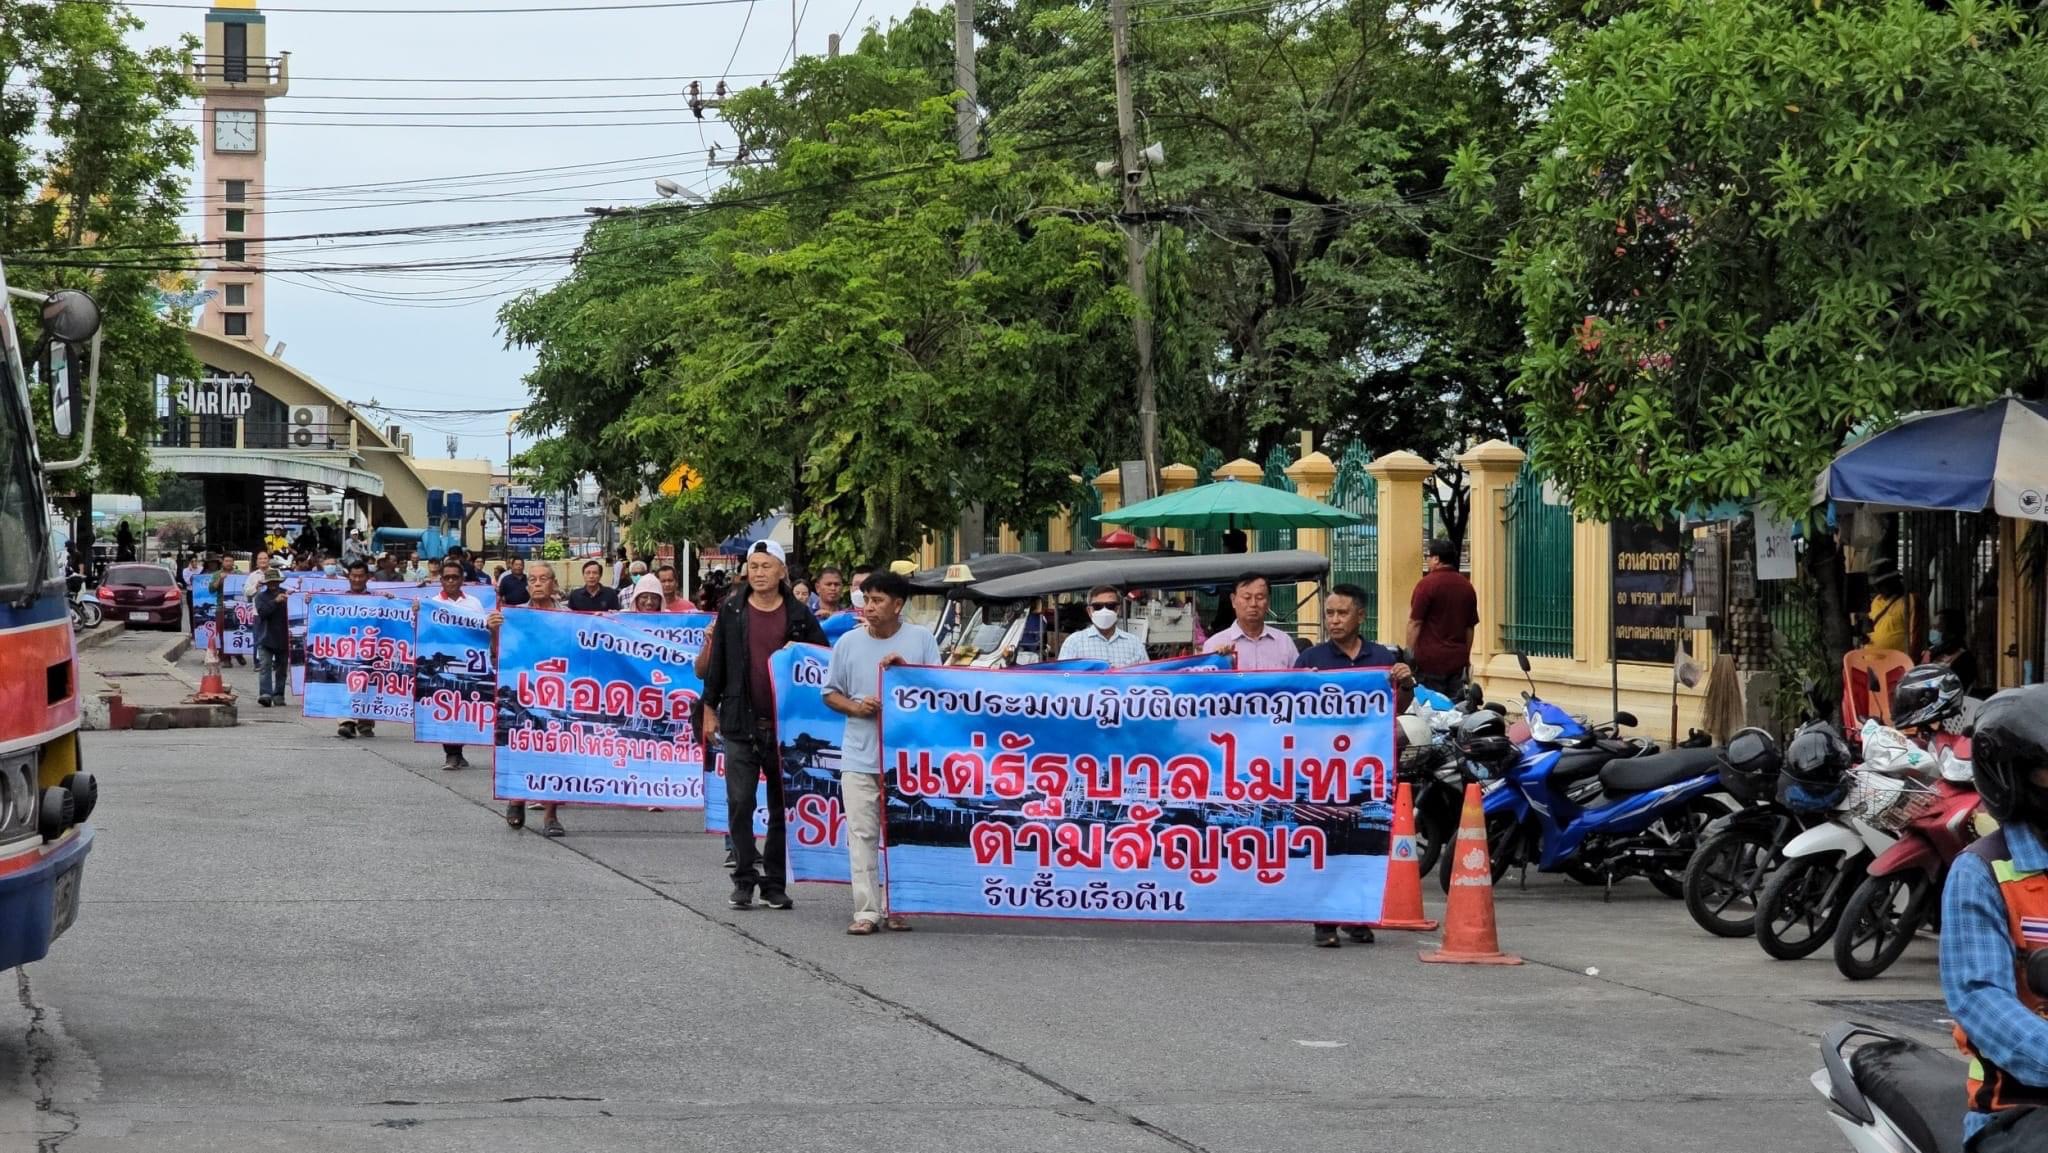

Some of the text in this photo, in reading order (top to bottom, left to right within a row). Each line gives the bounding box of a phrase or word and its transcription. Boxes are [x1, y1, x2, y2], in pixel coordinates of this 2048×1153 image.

[896, 732, 1386, 817] แต่รัฐบาลไม่ทำ
[971, 804, 1326, 884] ตามสัญญา
[983, 872, 1185, 912] รับซื้อเรือคืน
